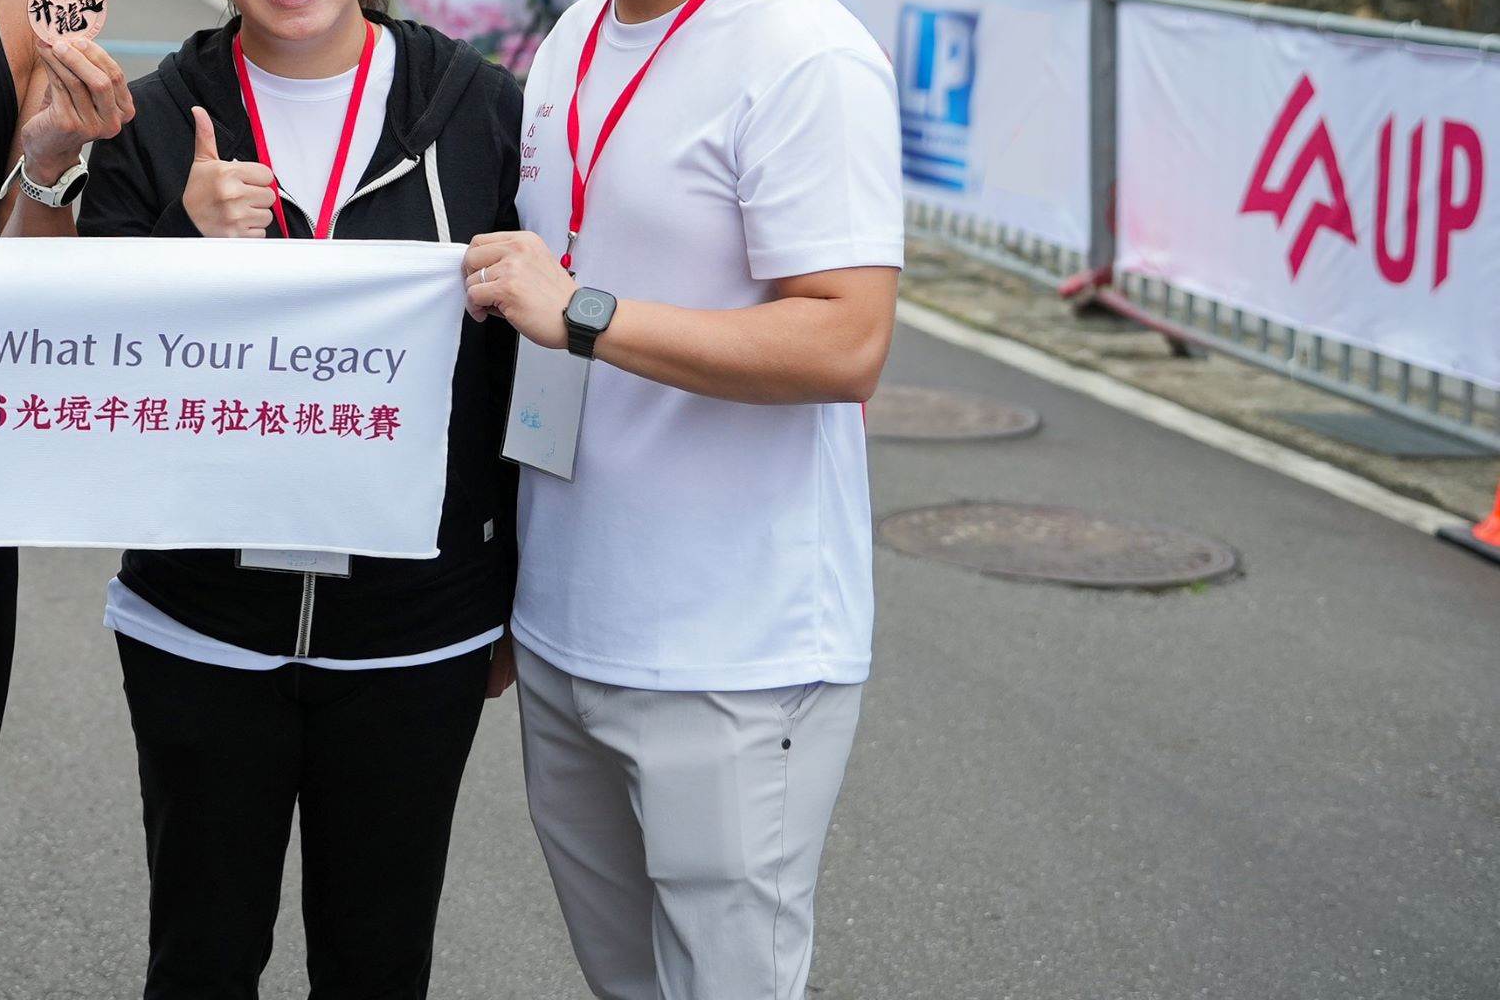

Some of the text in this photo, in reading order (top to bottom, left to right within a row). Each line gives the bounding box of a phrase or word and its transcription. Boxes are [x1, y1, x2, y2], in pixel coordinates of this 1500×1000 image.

[520, 165, 540, 182] egacy
[112, 332, 143, 367] Is
[157, 332, 254, 371] Your
[268, 336, 407, 383] Legacy
